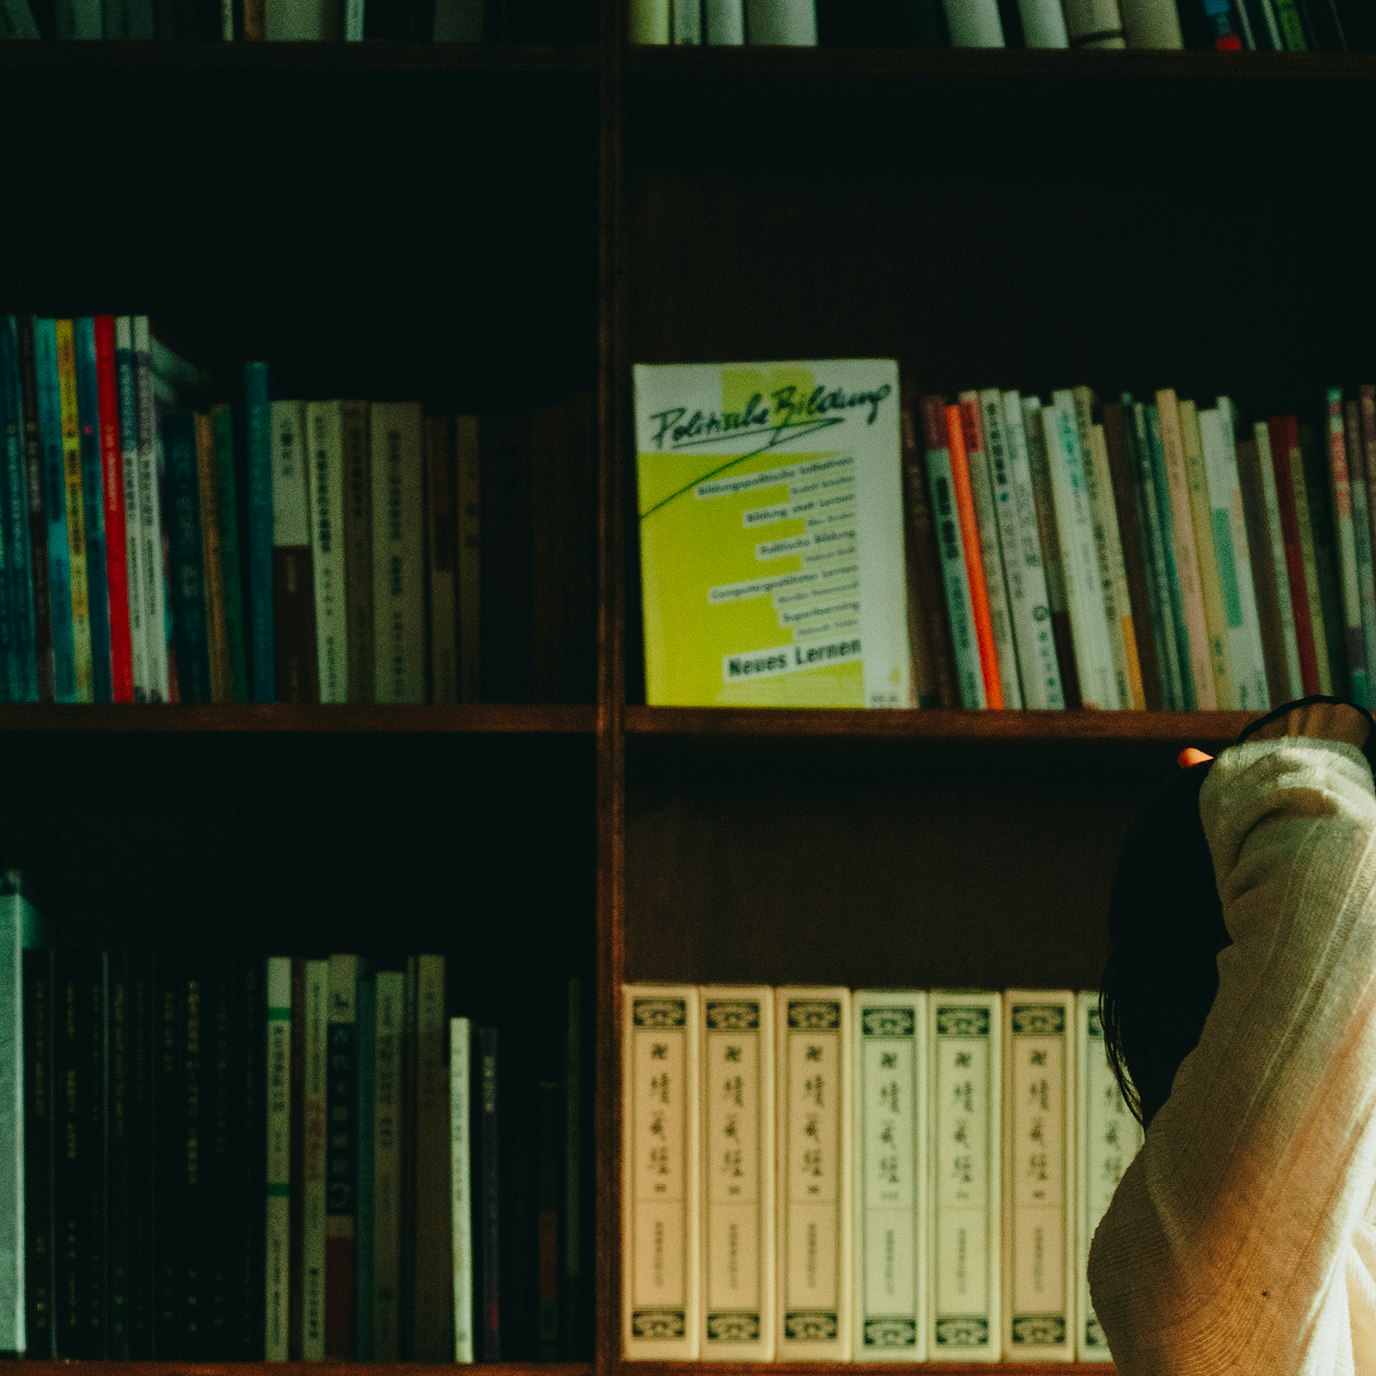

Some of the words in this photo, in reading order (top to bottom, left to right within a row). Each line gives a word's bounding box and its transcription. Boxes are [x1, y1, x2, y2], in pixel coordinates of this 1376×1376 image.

[650, 394, 767, 448] Politische
[769, 384, 892, 430] Bildung
[815, 531, 856, 545] Bildung
[728, 652, 788, 678] Neues
[794, 638, 862, 665] Lernen
